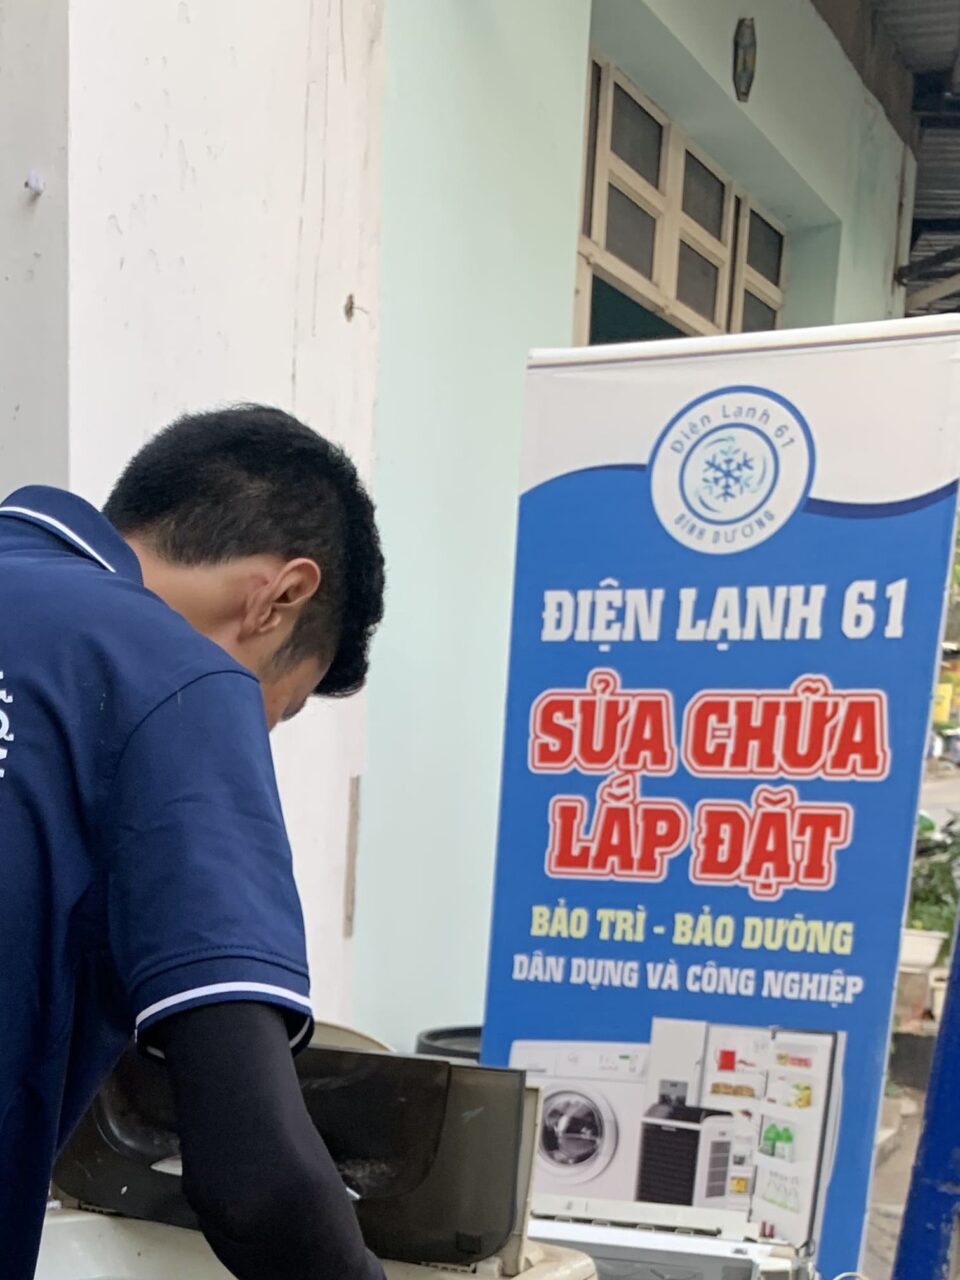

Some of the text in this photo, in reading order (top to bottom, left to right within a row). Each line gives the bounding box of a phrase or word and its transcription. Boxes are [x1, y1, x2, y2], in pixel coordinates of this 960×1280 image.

[774, 424, 796, 449] 61
[540, 577, 908, 652] ĐIỆN LẠNH 61
[529, 668, 890, 781] SỬA CHỮA
[545, 771, 853, 898] LẮP ĐẶT
[530, 898, 588, 939] BẢO
[596, 905, 646, 943] TRÌ
[673, 905, 735, 947] BẢO
[511, 950, 864, 1008] DÂN DỤNG VÀ CÔNG NGHIỆP
